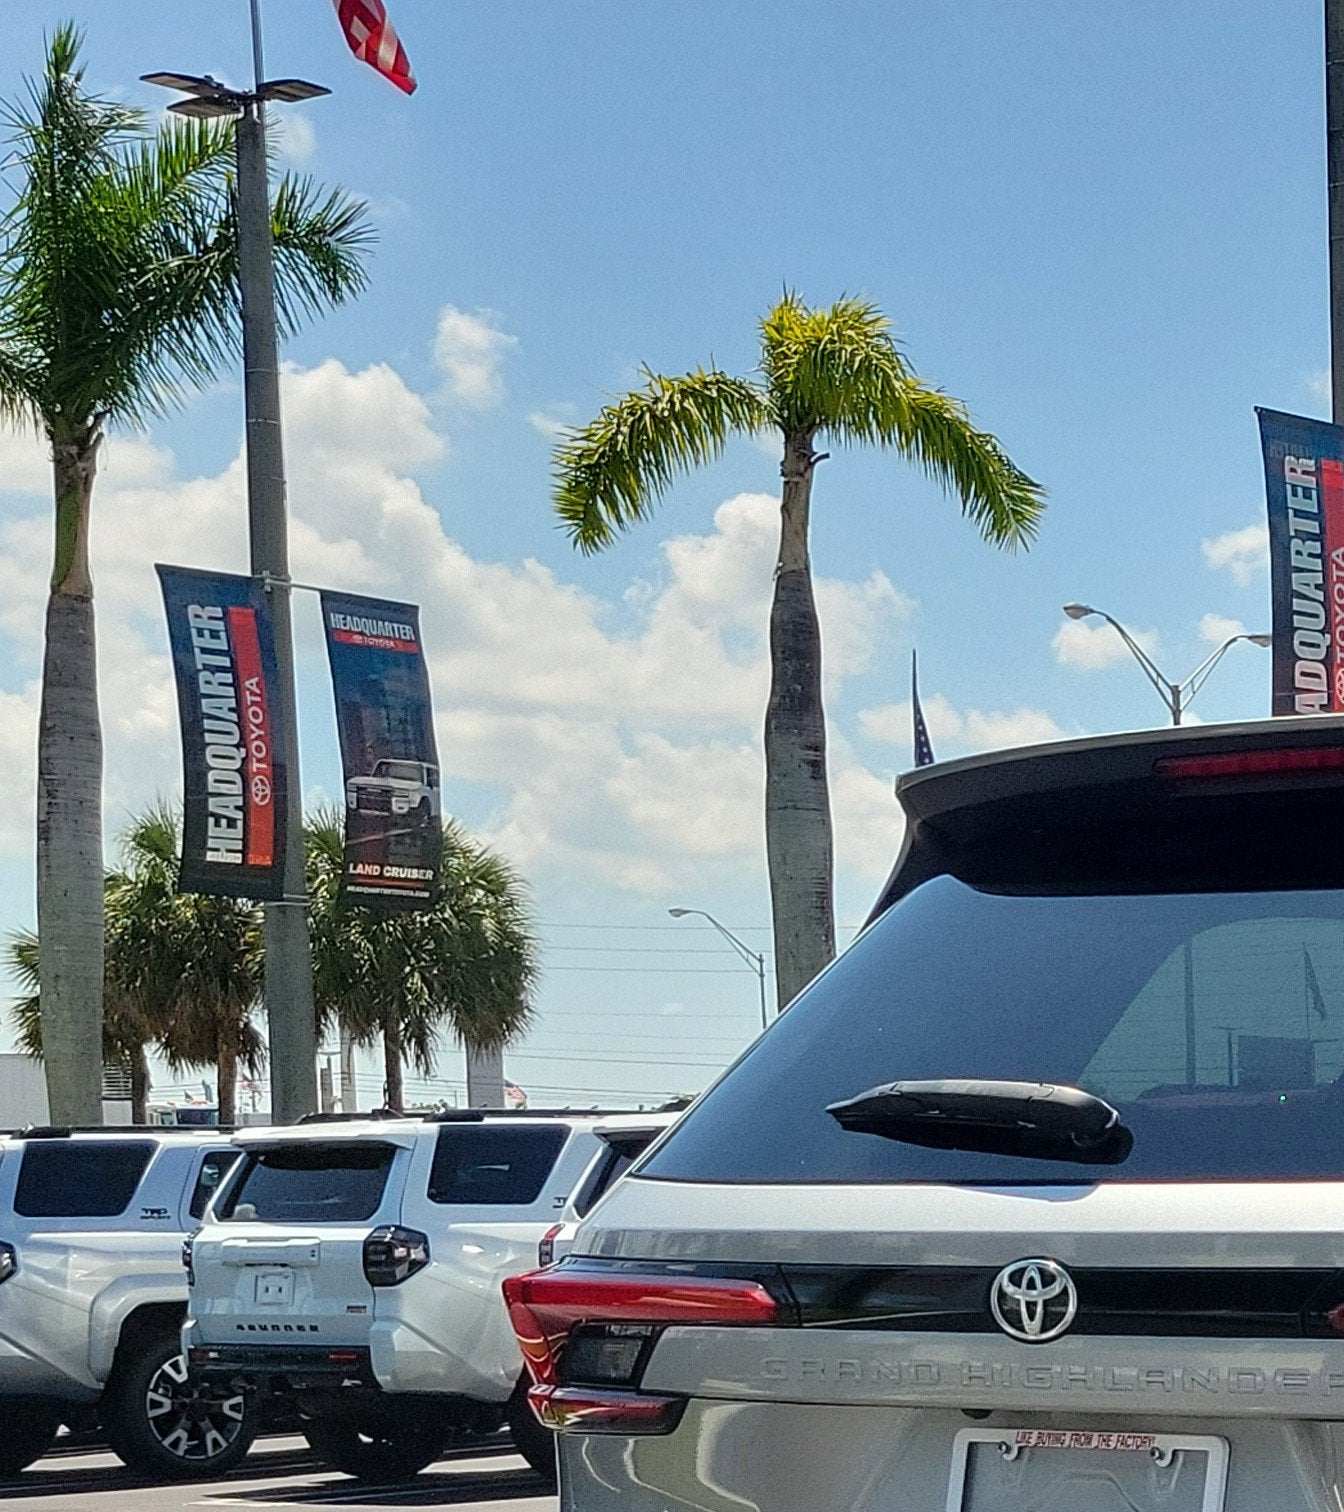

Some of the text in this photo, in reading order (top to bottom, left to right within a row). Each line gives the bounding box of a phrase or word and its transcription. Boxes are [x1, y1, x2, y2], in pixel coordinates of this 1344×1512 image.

[1284, 455, 1328, 714] ADQUARTER
[330, 612, 415, 640] HEADQUARTER
[187, 604, 245, 864] HEADQUARTER
[245, 677, 267, 773] TOYOTA
[349, 863, 434, 880] LAND CRUISER
[760, 1356, 941, 1386] GRAND
[1016, 1431, 1033, 1444] LIKE
[1036, 1432, 1067, 1446] BUYING
[1070, 1433, 1094, 1447] FROM
[1097, 1434, 1113, 1447] THE
